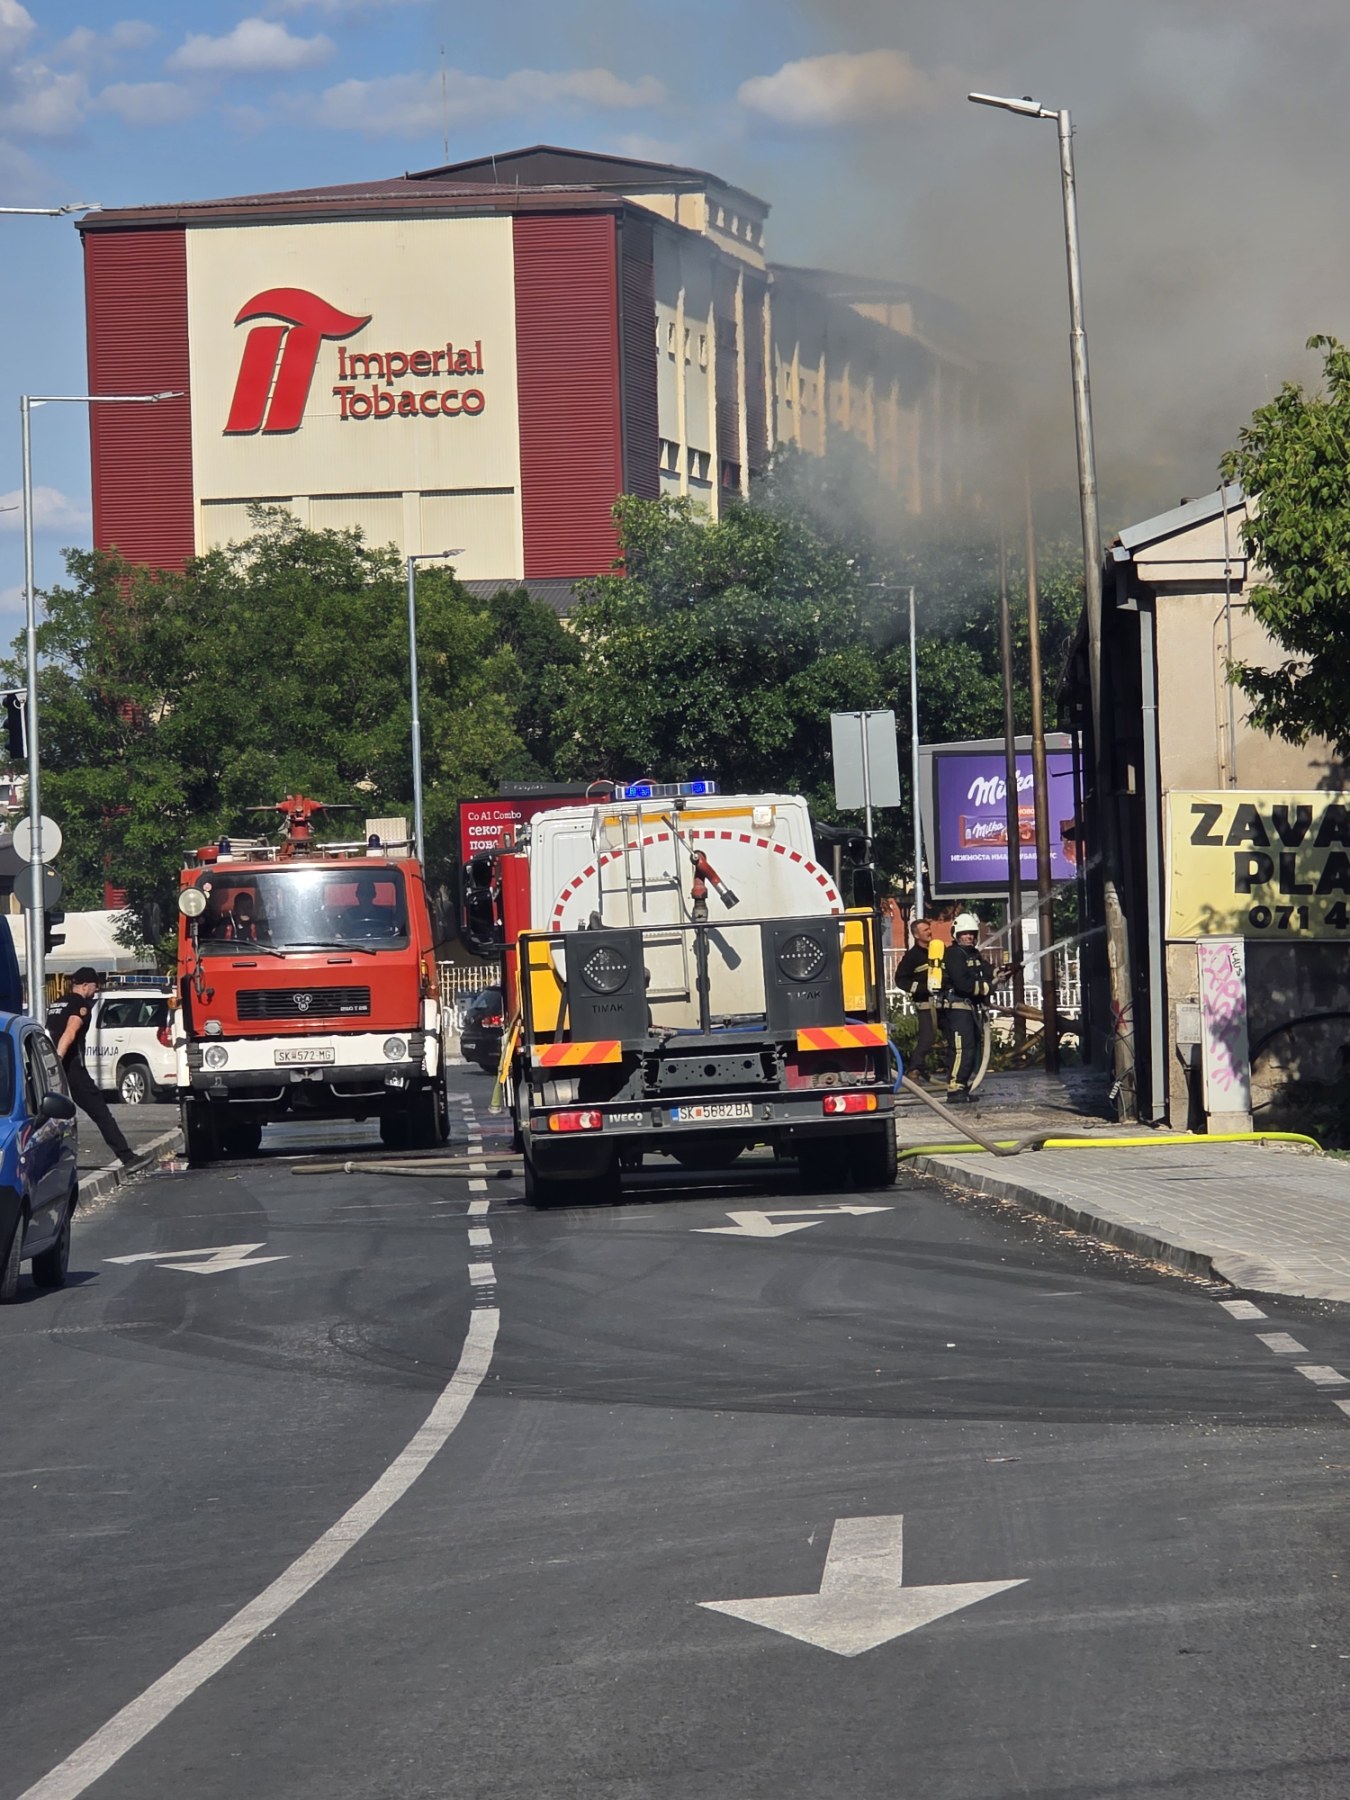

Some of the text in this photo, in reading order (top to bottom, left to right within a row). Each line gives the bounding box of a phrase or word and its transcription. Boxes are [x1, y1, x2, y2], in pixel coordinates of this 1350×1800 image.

[337, 340, 484, 386] Imperial
[332, 384, 486, 421] Tobacco
[967, 769, 1034, 807] Mika
[493, 810, 522, 820] Combo
[468, 825, 504, 836] секог
[972, 820, 1005, 839] Milka
[1233, 851, 1350, 895] PLA
[1249, 905, 1309, 930] 071
[591, 1003, 624, 1013] TIMAK
[85, 1046, 119, 1057] ЛИЦИЈА
[609, 1112, 643, 1123] IVECO
